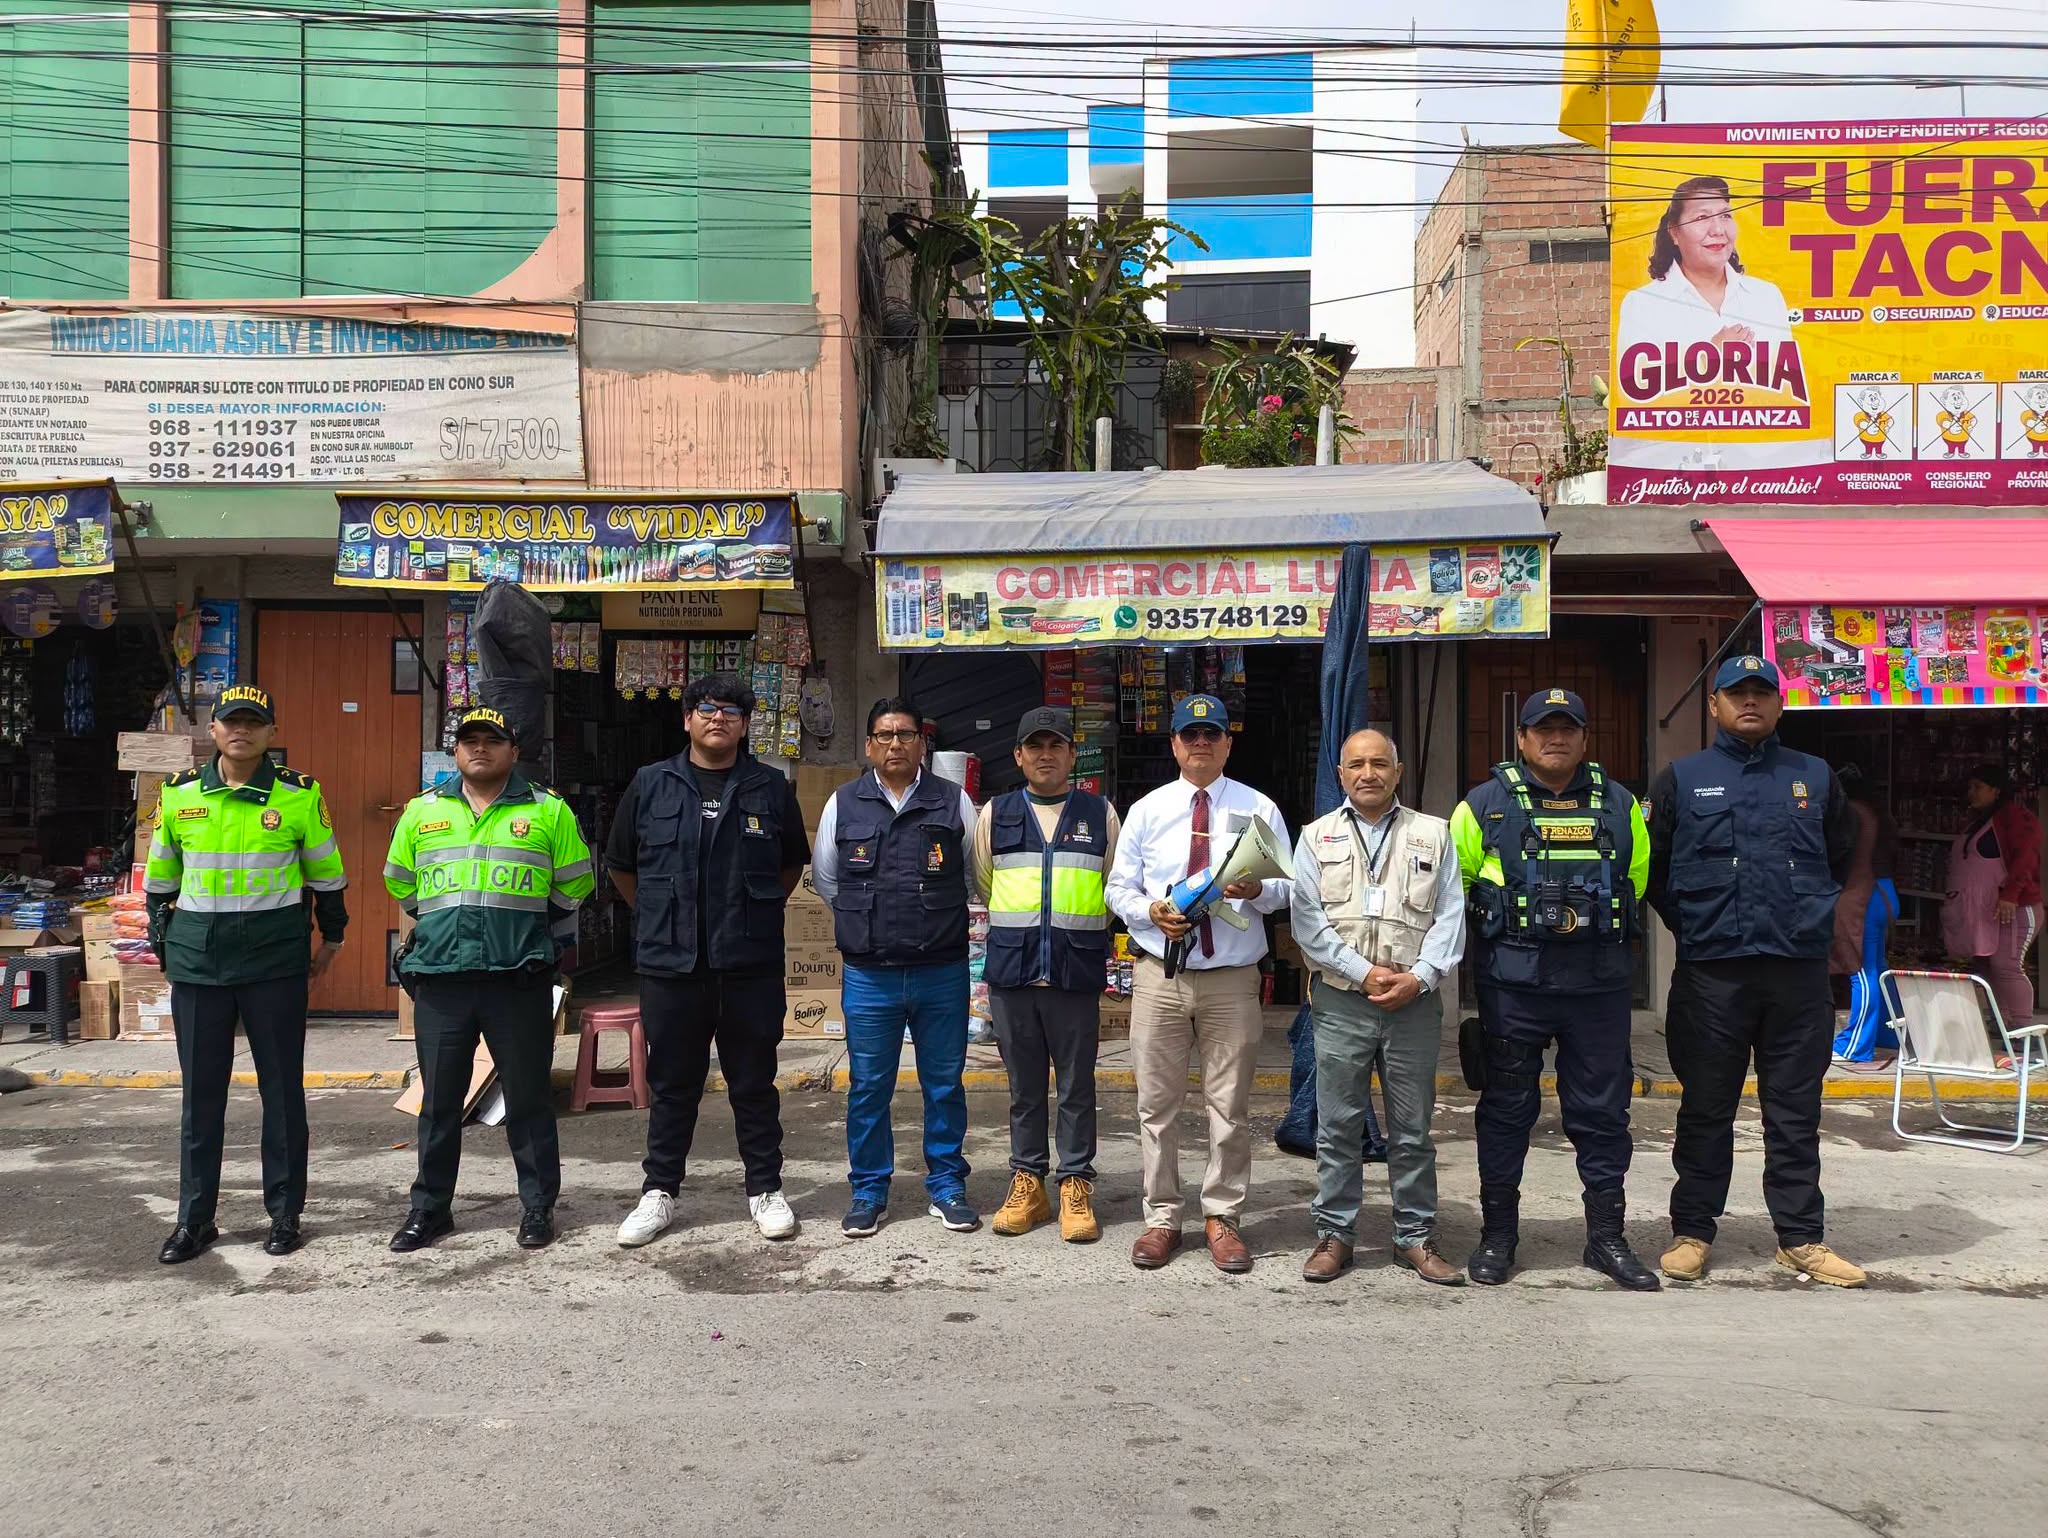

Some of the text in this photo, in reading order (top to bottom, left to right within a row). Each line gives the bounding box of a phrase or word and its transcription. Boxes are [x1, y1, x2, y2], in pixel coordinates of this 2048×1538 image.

[1726, 127, 1841, 142] MOVIMIENTO
[1845, 123, 1990, 139] INDEPENDIENTE
[1762, 158, 2048, 227] FUER
[1814, 309, 1861, 320] SALUD
[1890, 308, 1973, 320] SEGURIDAD
[51, 317, 217, 353] INMOBILIARIA
[224, 320, 298, 354] ASHLY
[309, 320, 323, 353] E
[1619, 340, 1808, 402] GLORIA
[1850, 372, 1889, 382] MARCA
[1933, 371, 1972, 381] MARCA
[11, 381, 28, 391] 130,
[31, 381, 45, 390] 140
[47, 382, 53, 390] Y
[55, 382, 69, 391] 150
[104, 376, 515, 395] PARA COMPRAR SU LOTE CON TITULO DE PROPIEDAD EN CONO SUR
[29, 395, 40, 403] DE
[42, 396, 89, 404] PROPIEDAD
[1689, 389, 1744, 405] 2026
[9, 407, 50, 417] (SUNARP)
[147, 400, 387, 414] SI DESEA MAYOR INFORMACIÓN:
[36, 420, 48, 428] UN
[50, 420, 88, 429] NOTARIO
[310, 418, 380, 428] NOS PUEDE UBICAR
[1623, 410, 1682, 428] ALTO
[1685, 418, 1700, 427] LA
[1701, 409, 1802, 427] ALIANZA
[149, 419, 190, 436] 968
[213, 419, 297, 436] 111937
[1, 432, 86, 441] ESCRITURA PUBLICA
[310, 430, 385, 439] EN NUESTRA OFICINA
[26, 445, 37, 453] DE
[38, 445, 77, 453] TERRENO
[149, 441, 190, 457] 937
[213, 441, 296, 457] 629061
[310, 441, 413, 451] EN CONO SUR AV. HUMBOLDT
[0, 457, 124, 468] ON AGUA (PILETAS PUBLICAS)
[310, 455, 331, 464] ASOC.
[334, 455, 353, 463] VILLA
[371, 454, 396, 463] ROCAS
[149, 463, 190, 479] 958
[213, 463, 296, 479] 214491
[1925, 471, 1991, 481] CONSEJERO
[1837, 473, 1912, 482] GOBERNADOR
[1621, 476, 1822, 503] ¡Juntos por el cambio!
[1847, 481, 1902, 490] REGIONAL
[1930, 480, 1986, 489] REGIONAL
[371, 502, 596, 542] COMERCIAL
[996, 558, 1417, 601] COMERCIAL LUA
[1471, 573, 1488, 583] Ace
[641, 590, 719, 604] PANTENE
[639, 605, 681, 617] NUTRICIÓN
[1147, 604, 1308, 630] 935748129
[1048, 622, 1079, 631] Colgate
[220, 686, 269, 709] POLICIA
[462, 708, 505, 728] POLICIA
[184, 870, 288, 895] OLICIA
[422, 863, 534, 892] POLICIA
[793, 960, 836, 977] Downy
